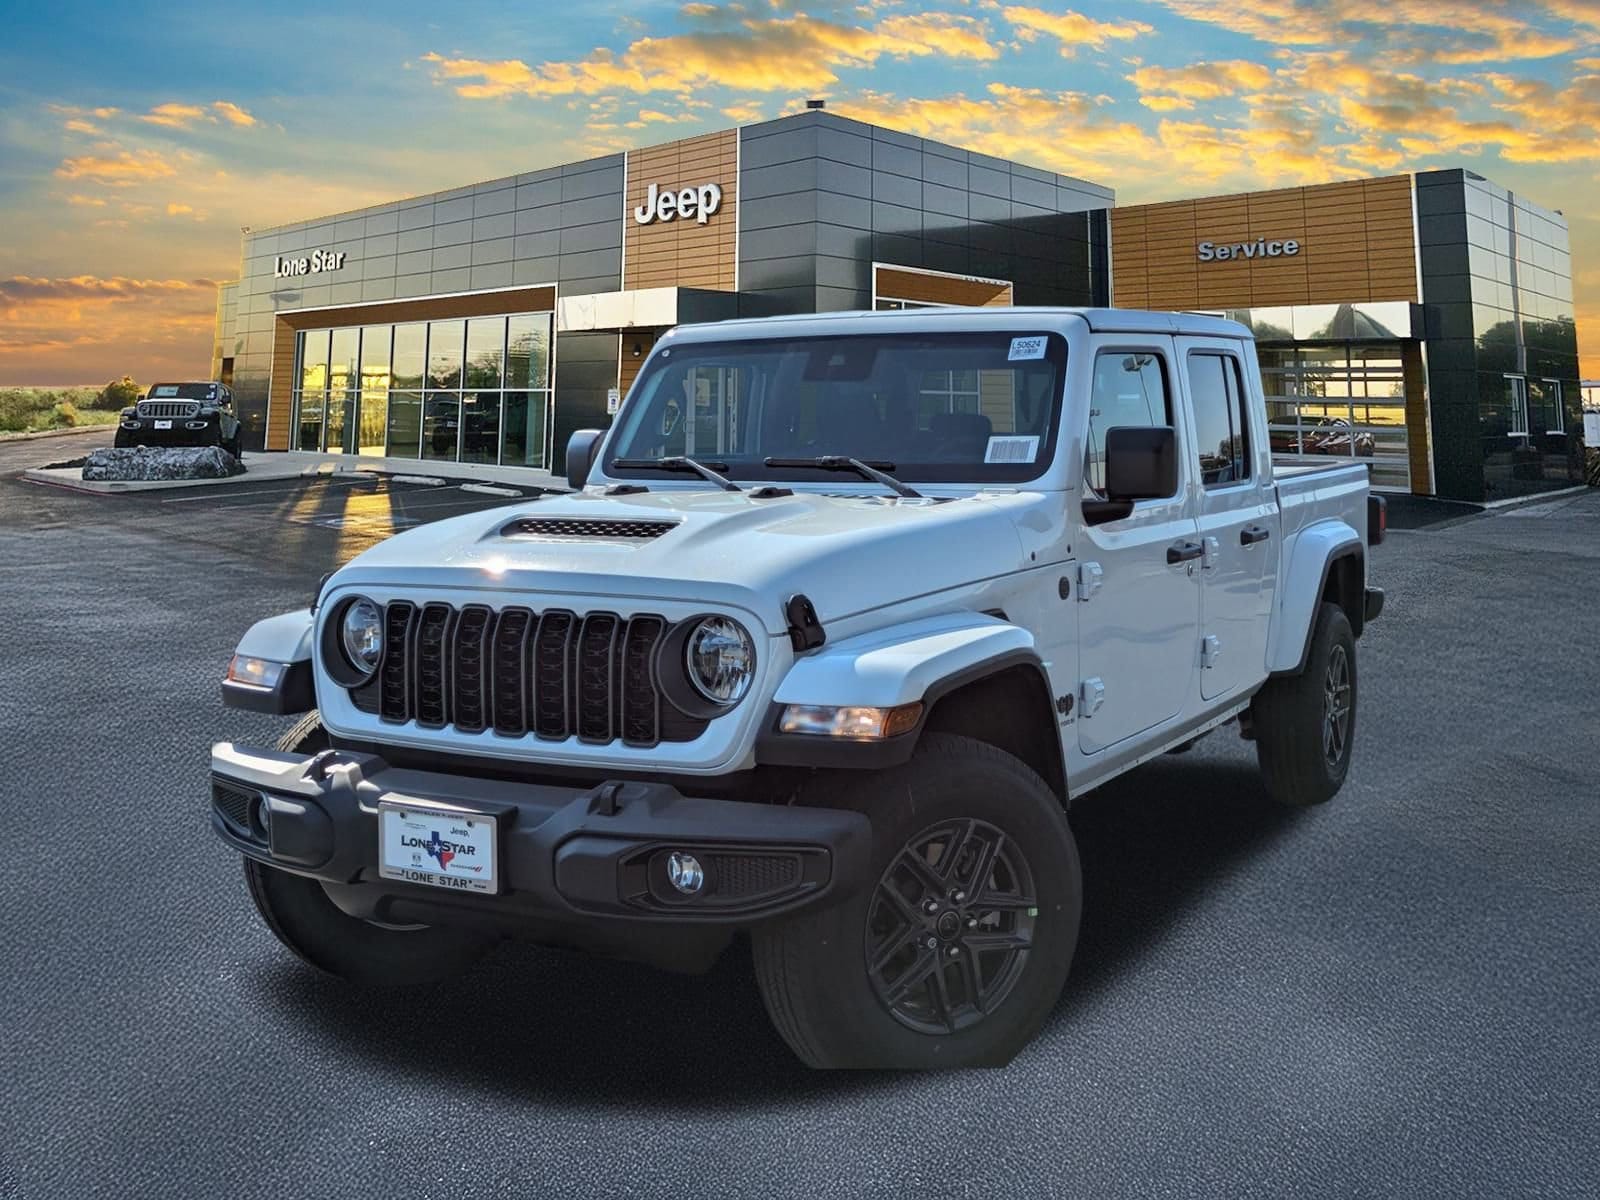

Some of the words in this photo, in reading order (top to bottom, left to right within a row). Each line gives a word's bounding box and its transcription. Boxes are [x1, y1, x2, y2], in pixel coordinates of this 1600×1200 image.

[634, 182, 721, 224] Jeep
[1198, 236, 1299, 261] Service
[274, 256, 309, 278] Lone
[311, 249, 346, 273] Star
[441, 841, 476, 856] STAR
[405, 870, 434, 883] LONE
[439, 875, 467, 888] STAR
